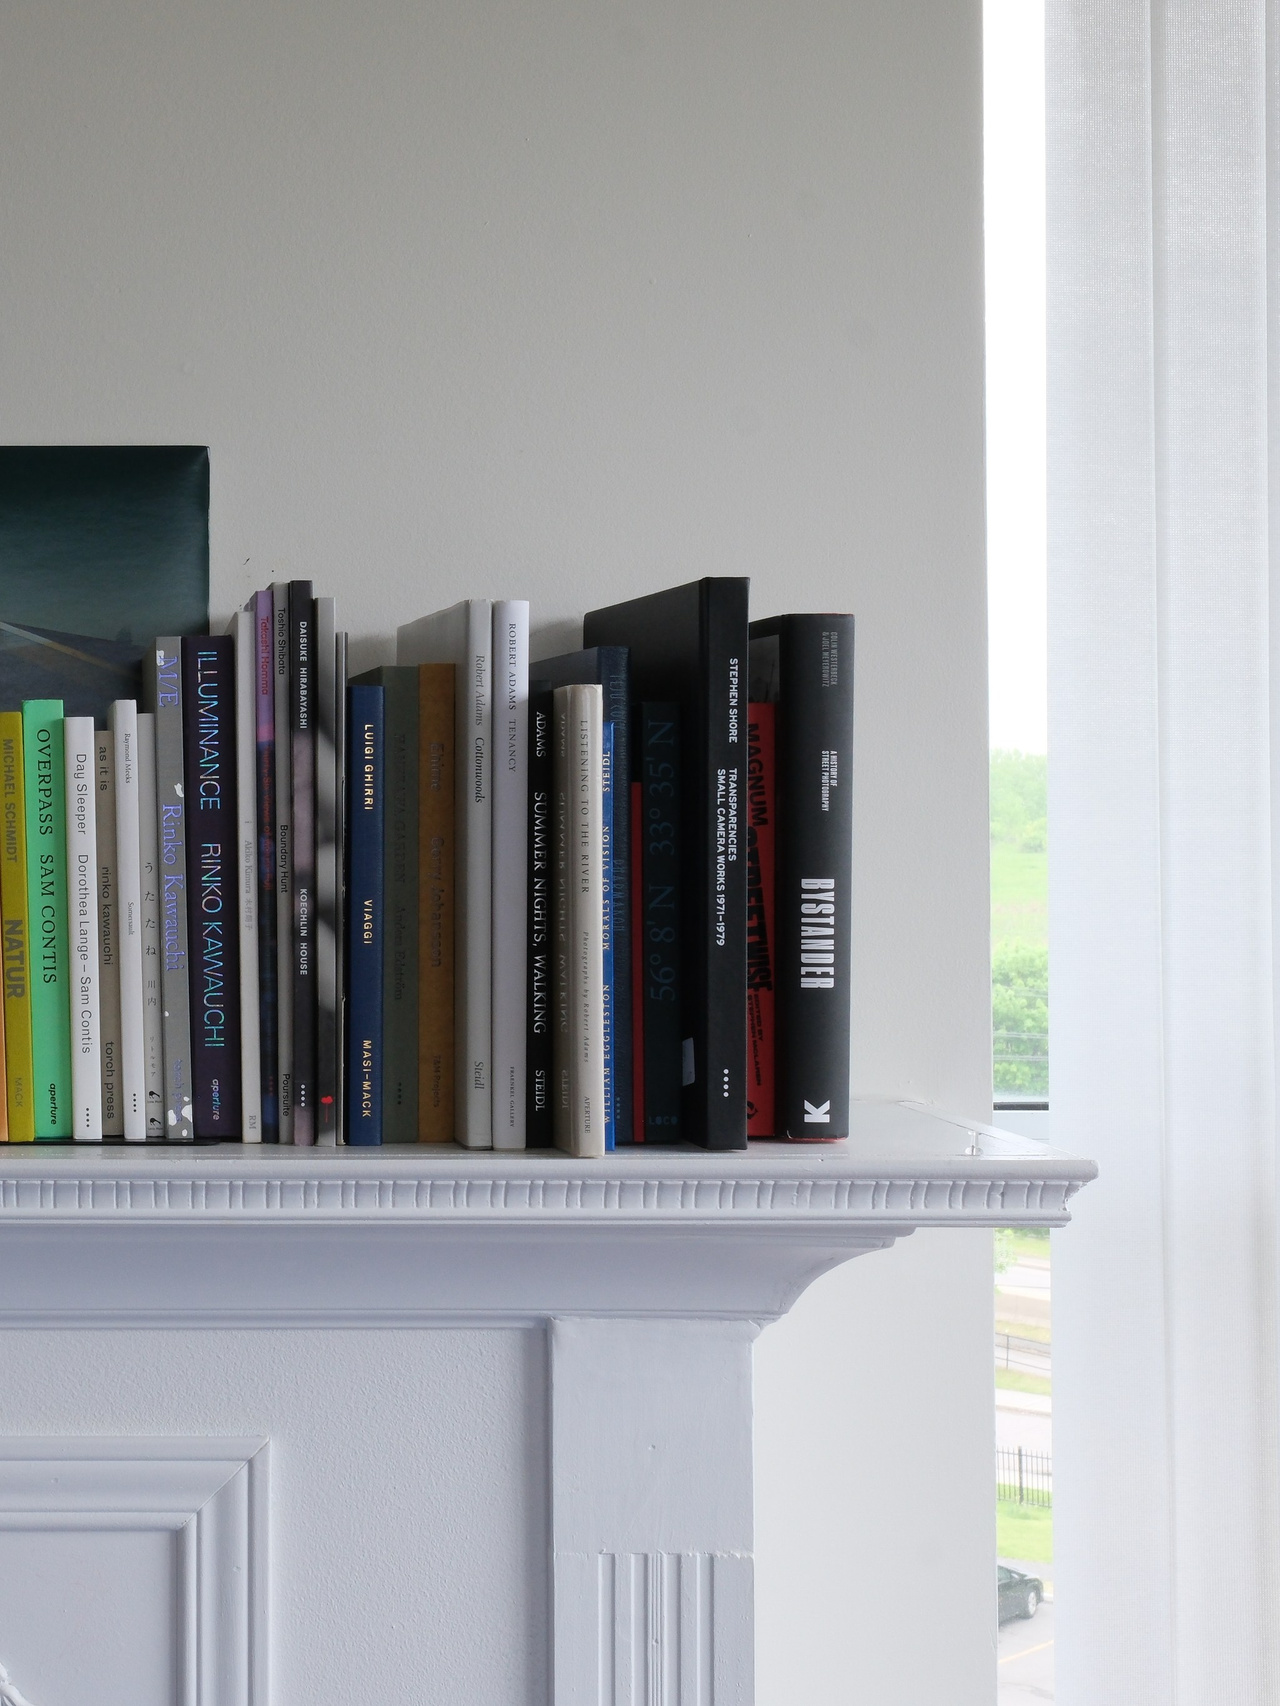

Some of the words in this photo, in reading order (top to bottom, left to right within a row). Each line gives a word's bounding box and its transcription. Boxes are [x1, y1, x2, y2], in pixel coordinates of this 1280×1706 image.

[260, 616, 270, 655] Takashi
[277, 608, 286, 638] Toshio
[299, 621, 308, 662] DAISUKE
[830, 631, 838, 648] COLIN
[278, 639, 287, 675] Shibata
[508, 623, 516, 667] ROBERT
[822, 637, 830, 651] JOEL
[158, 655, 180, 707] M/E
[261, 656, 270, 696] Homma
[475, 655, 486, 688] Robert
[729, 657, 739, 706] STEPHEN
[822, 652, 830, 688] MEYEROWITZ
[830, 649, 838, 685] WESTERBECK
[299, 667, 308, 729] HIRABAYASHI
[475, 690, 486, 726] Adams
[508, 671, 516, 711] ADAMS
[197, 651, 221, 810] ILLUMINANCE
[364, 724, 374, 759] LUIGI
[508, 720, 516, 772] TENANCY
[536, 711, 547, 758] ADAMS
[648, 720, 674, 745] N
[728, 708, 738, 743] SHORE
[74, 754, 87, 779] Day
[99, 746, 107, 761] as
[124, 733, 132, 762] Raymond
[580, 720, 589, 792] LISTENING
[822, 750, 830, 771] STREET
[830, 755, 838, 779] HISTORY
[3, 739, 16, 798] MICHAEL
[37, 728, 53, 835] OVERPASS
[364, 764, 374, 810] GHIRRI
[475, 737, 486, 803] Cottonwoods
[602, 751, 610, 792] STEIDL
[717, 768, 726, 805] SMALL
[747, 723, 768, 827] MAGNUM
[75, 784, 88, 835] Sleeper
[581, 800, 589, 815] TO
[822, 772, 830, 812] PHOTOGRAPHY
[5, 803, 17, 862] SCHMIDT
[162, 804, 183, 865] Rinko
[533, 791, 547, 871] SUMMER
[581, 823, 589, 847] THE
[716, 808, 726, 853] CAMERA
[728, 768, 738, 861] TRANSPARENCIES
[280, 824, 289, 870] Boundary
[602, 826, 610, 870] VISION
[40, 854, 55, 897] SAM
[78, 854, 90, 916] Dorothea
[101, 866, 112, 899] rinko
[201, 843, 223, 914] RINKO
[245, 865, 253, 894] Kimura
[280, 871, 289, 893] Hunt
[581, 855, 589, 893] RIVER
[602, 878, 610, 892] OF
[716, 855, 726, 891] WORKS
[300, 888, 308, 936] KOECHLIN
[532, 877, 547, 947] NIGHTS,
[649, 885, 674, 910] N
[77, 921, 90, 961] Lange
[102, 904, 114, 965] kawauchi
[164, 874, 186, 972] Kawauchi
[363, 899, 373, 944] VIAGGI
[602, 899, 610, 950] MORALS
[801, 878, 835, 989] BYSTANDER
[4, 919, 26, 999] NATUR
[41, 905, 57, 983] CONTIS
[300, 942, 308, 976] HOUSE
[80, 976, 91, 1005] Sam
[202, 922, 225, 1047] KAWAUCHI
[533, 954, 547, 1034] WALKING
[754, 993, 762, 1028] EDITED
[81, 1010, 93, 1054] Contis
[105, 1040, 116, 1077] torch
[474, 1061, 485, 1090] Steidl
[48, 1083, 58, 1125] aperture
[104, 1082, 115, 1119] press
[211, 1078, 222, 1121] aperture
[535, 1069, 546, 1112] STEIDL
[603, 1067, 611, 1124] WILLIAM
[803, 1100, 831, 1123] K
